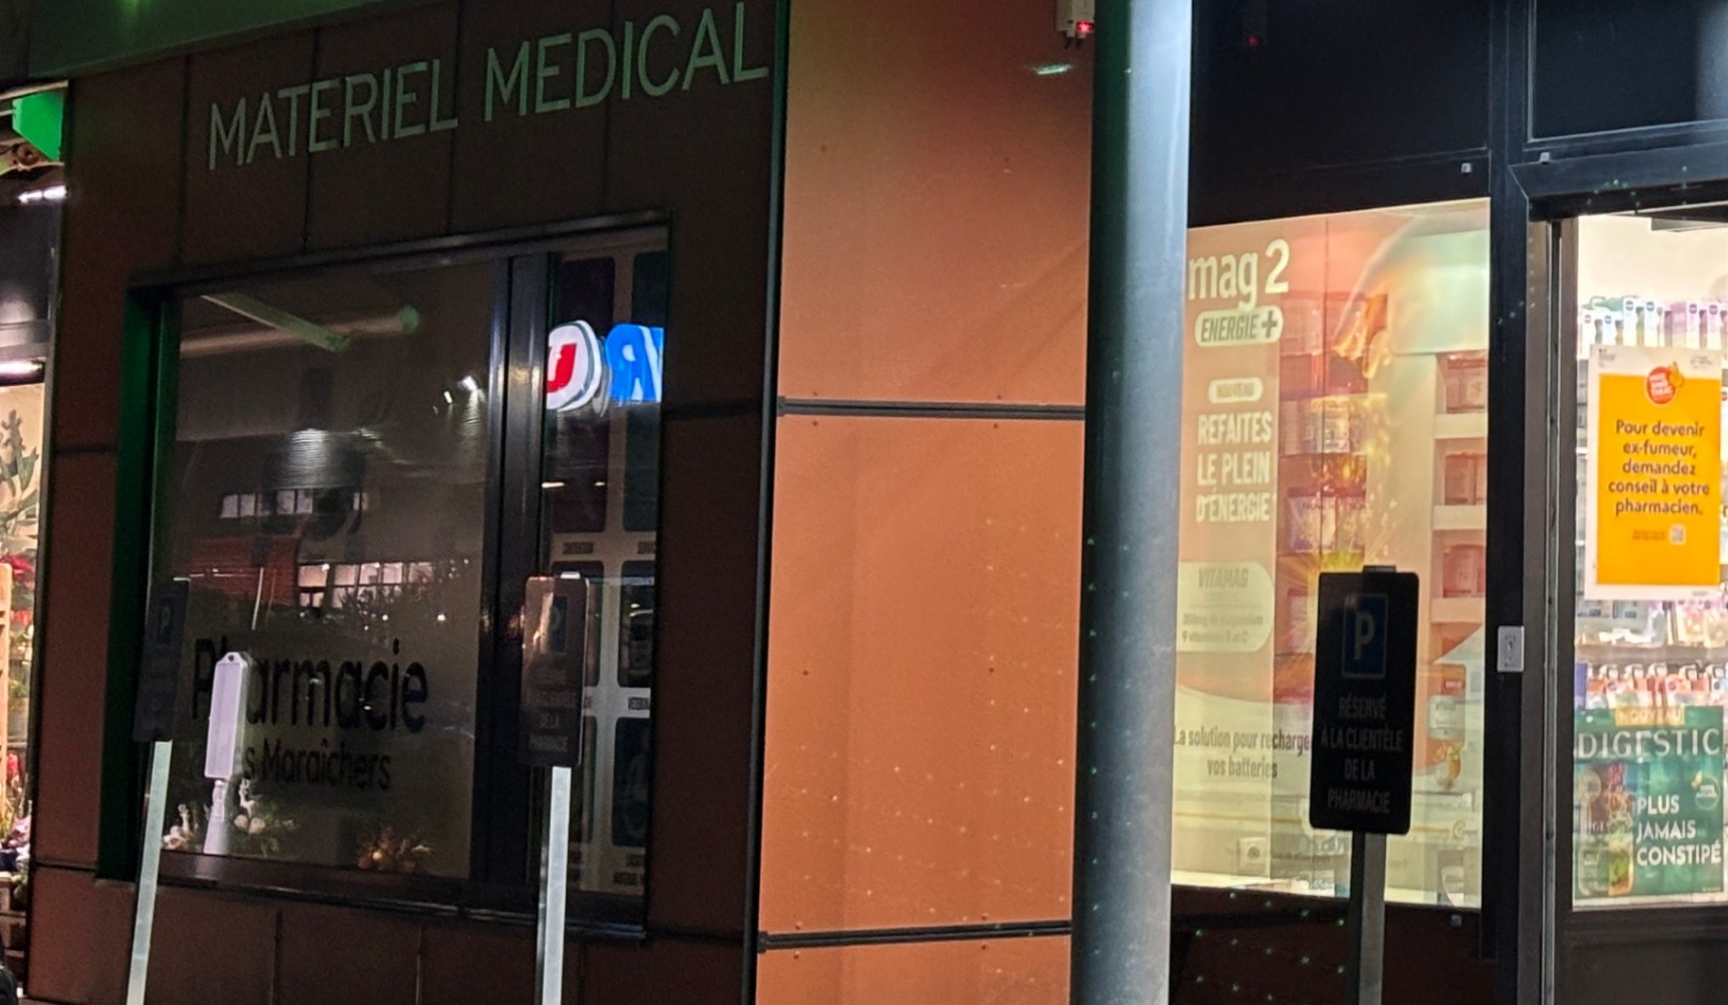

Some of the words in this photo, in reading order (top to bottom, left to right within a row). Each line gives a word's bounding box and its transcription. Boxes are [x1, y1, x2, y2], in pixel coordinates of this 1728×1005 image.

[209, 58, 459, 169] MATERIEL
[485, 2, 769, 121] MEDICAL
[1188, 251, 1259, 311] mag
[1264, 238, 1290, 294] 2
[1197, 410, 1272, 445] REFAITES
[1616, 419, 1648, 436] Pour
[1652, 420, 1704, 437] devenir
[1623, 439, 1697, 458] ex-fumeur,
[1197, 453, 1217, 486] LE
[1222, 451, 1271, 485] PLEIN
[1622, 459, 1695, 475] demandez
[1608, 480, 1657, 494] conseil
[1661, 479, 1669, 494] à
[1673, 482, 1710, 495] votre
[1196, 487, 1271, 523] D'ÉNERGIE
[1615, 498, 1704, 516] pharmacien.
[1354, 611, 1376, 661] P
[192, 636, 428, 733] Parmacie
[1338, 692, 1387, 720] RÉSERVÉ
[1188, 726, 1231, 748] solution
[1233, 731, 1257, 752] pour
[1260, 729, 1311, 757] recharge
[1332, 728, 1343, 750] LA
[1347, 725, 1404, 752] CLIENTÈLE
[1577, 727, 1720, 759] DIGESTIC
[261, 737, 391, 790] Maraîchers
[1207, 759, 1226, 776] vos
[1228, 756, 1278, 778] batteries
[1344, 758, 1359, 780] DE
[1361, 759, 1376, 781] LA
[1326, 786, 1391, 815] PHARMACIE
[1637, 794, 1680, 815] PLUS
[1636, 819, 1696, 844] JAMAIS
[1636, 839, 1722, 867] CONSTIPÉ
